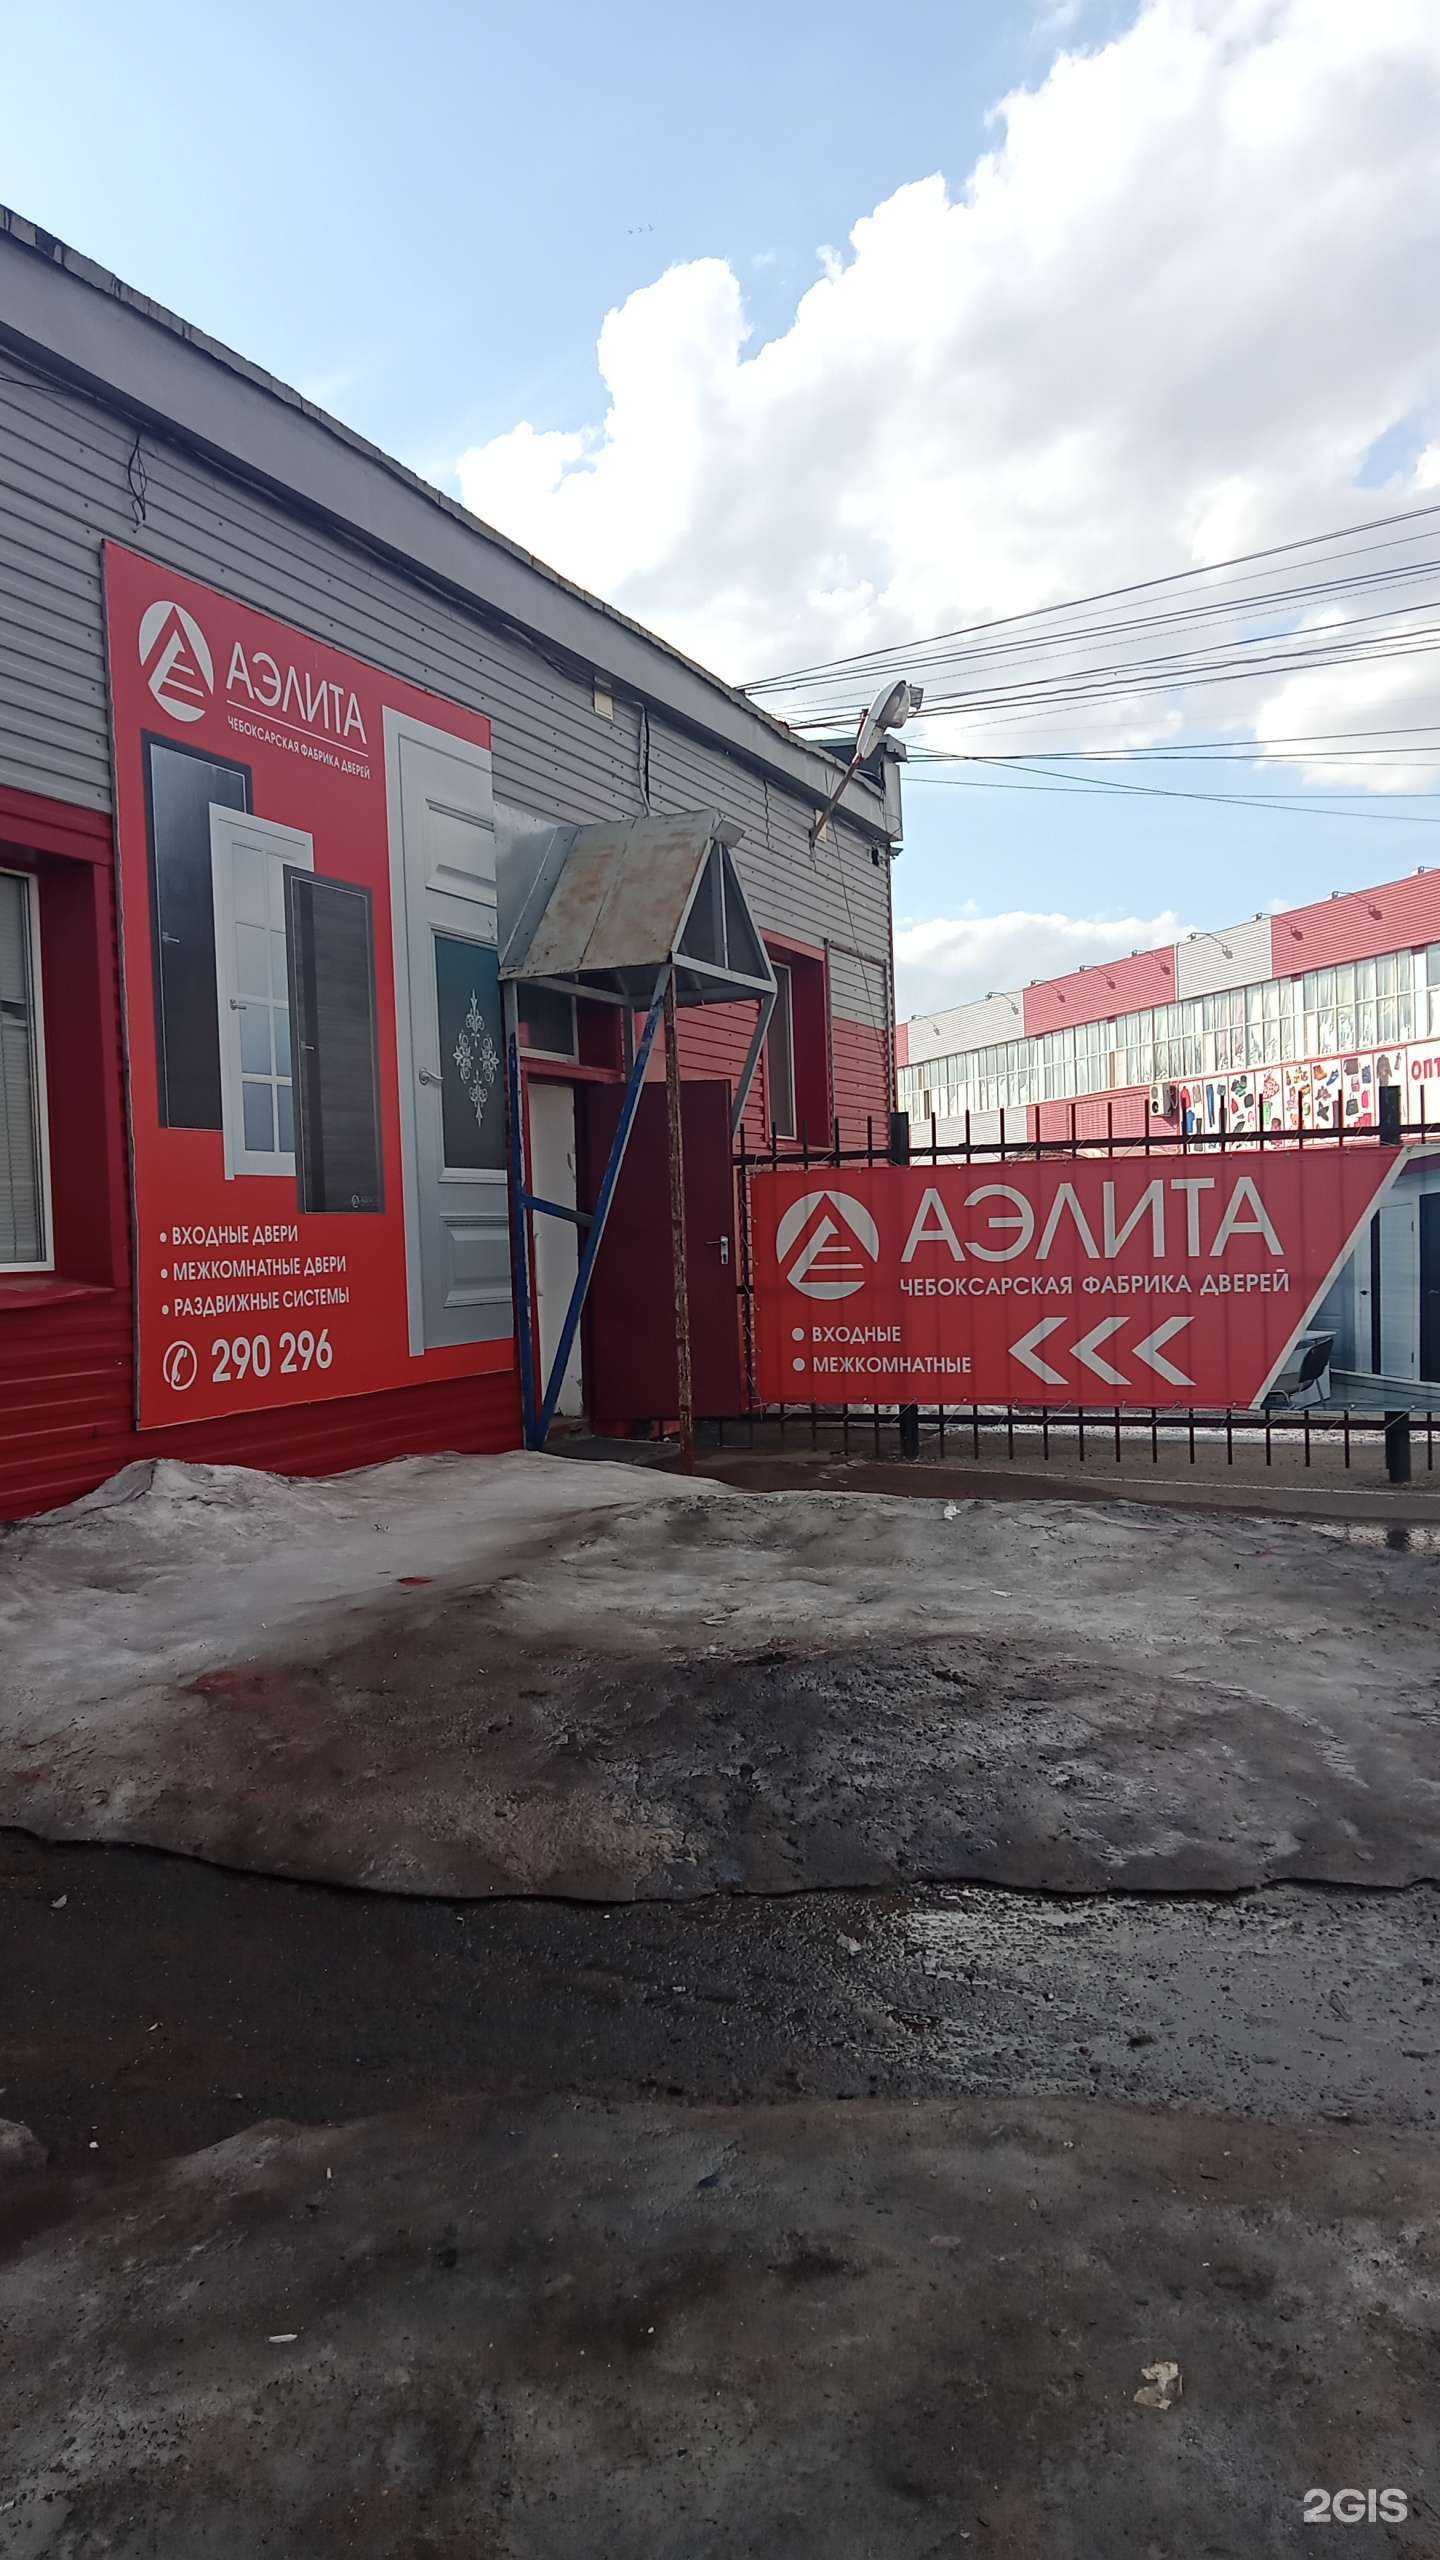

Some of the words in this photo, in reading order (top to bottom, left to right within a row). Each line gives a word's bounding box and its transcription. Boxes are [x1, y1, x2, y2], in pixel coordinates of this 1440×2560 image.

[226, 641, 368, 744] АЭЛИТА
[227, 715, 300, 753] ЧЕБОКСАРСКАЯ
[300, 744, 340, 769] ФАБРИКА
[341, 760, 371, 779] ДВЕРЕЙ
[900, 1176, 1285, 1264] АЭЛИТА
[171, 1226, 249, 1247] ВХОДНЫЕ
[252, 1225, 299, 1246] ДВЕРИ
[173, 1257, 301, 1281] МЕЖКОМНАТНЫЕ
[303, 1255, 346, 1276] ДВЕРИ
[900, 1274, 1073, 1298] ЧЕБОКСАРСКАЯ
[1081, 1272, 1193, 1296] ФАБРИКА
[1200, 1267, 1290, 1295] ДВЕРЕЙ
[174, 1291, 280, 1317] РАЗДВИЖНЫЕ
[282, 1287, 350, 1308] СИСТЕМЫ
[812, 1325, 902, 1345] ВХОДНЫЕ
[211, 1334, 271, 1383] 290
[279, 1328, 333, 1374] 296
[812, 1355, 972, 1375] МЕЖКОМНАТНЫЕ
